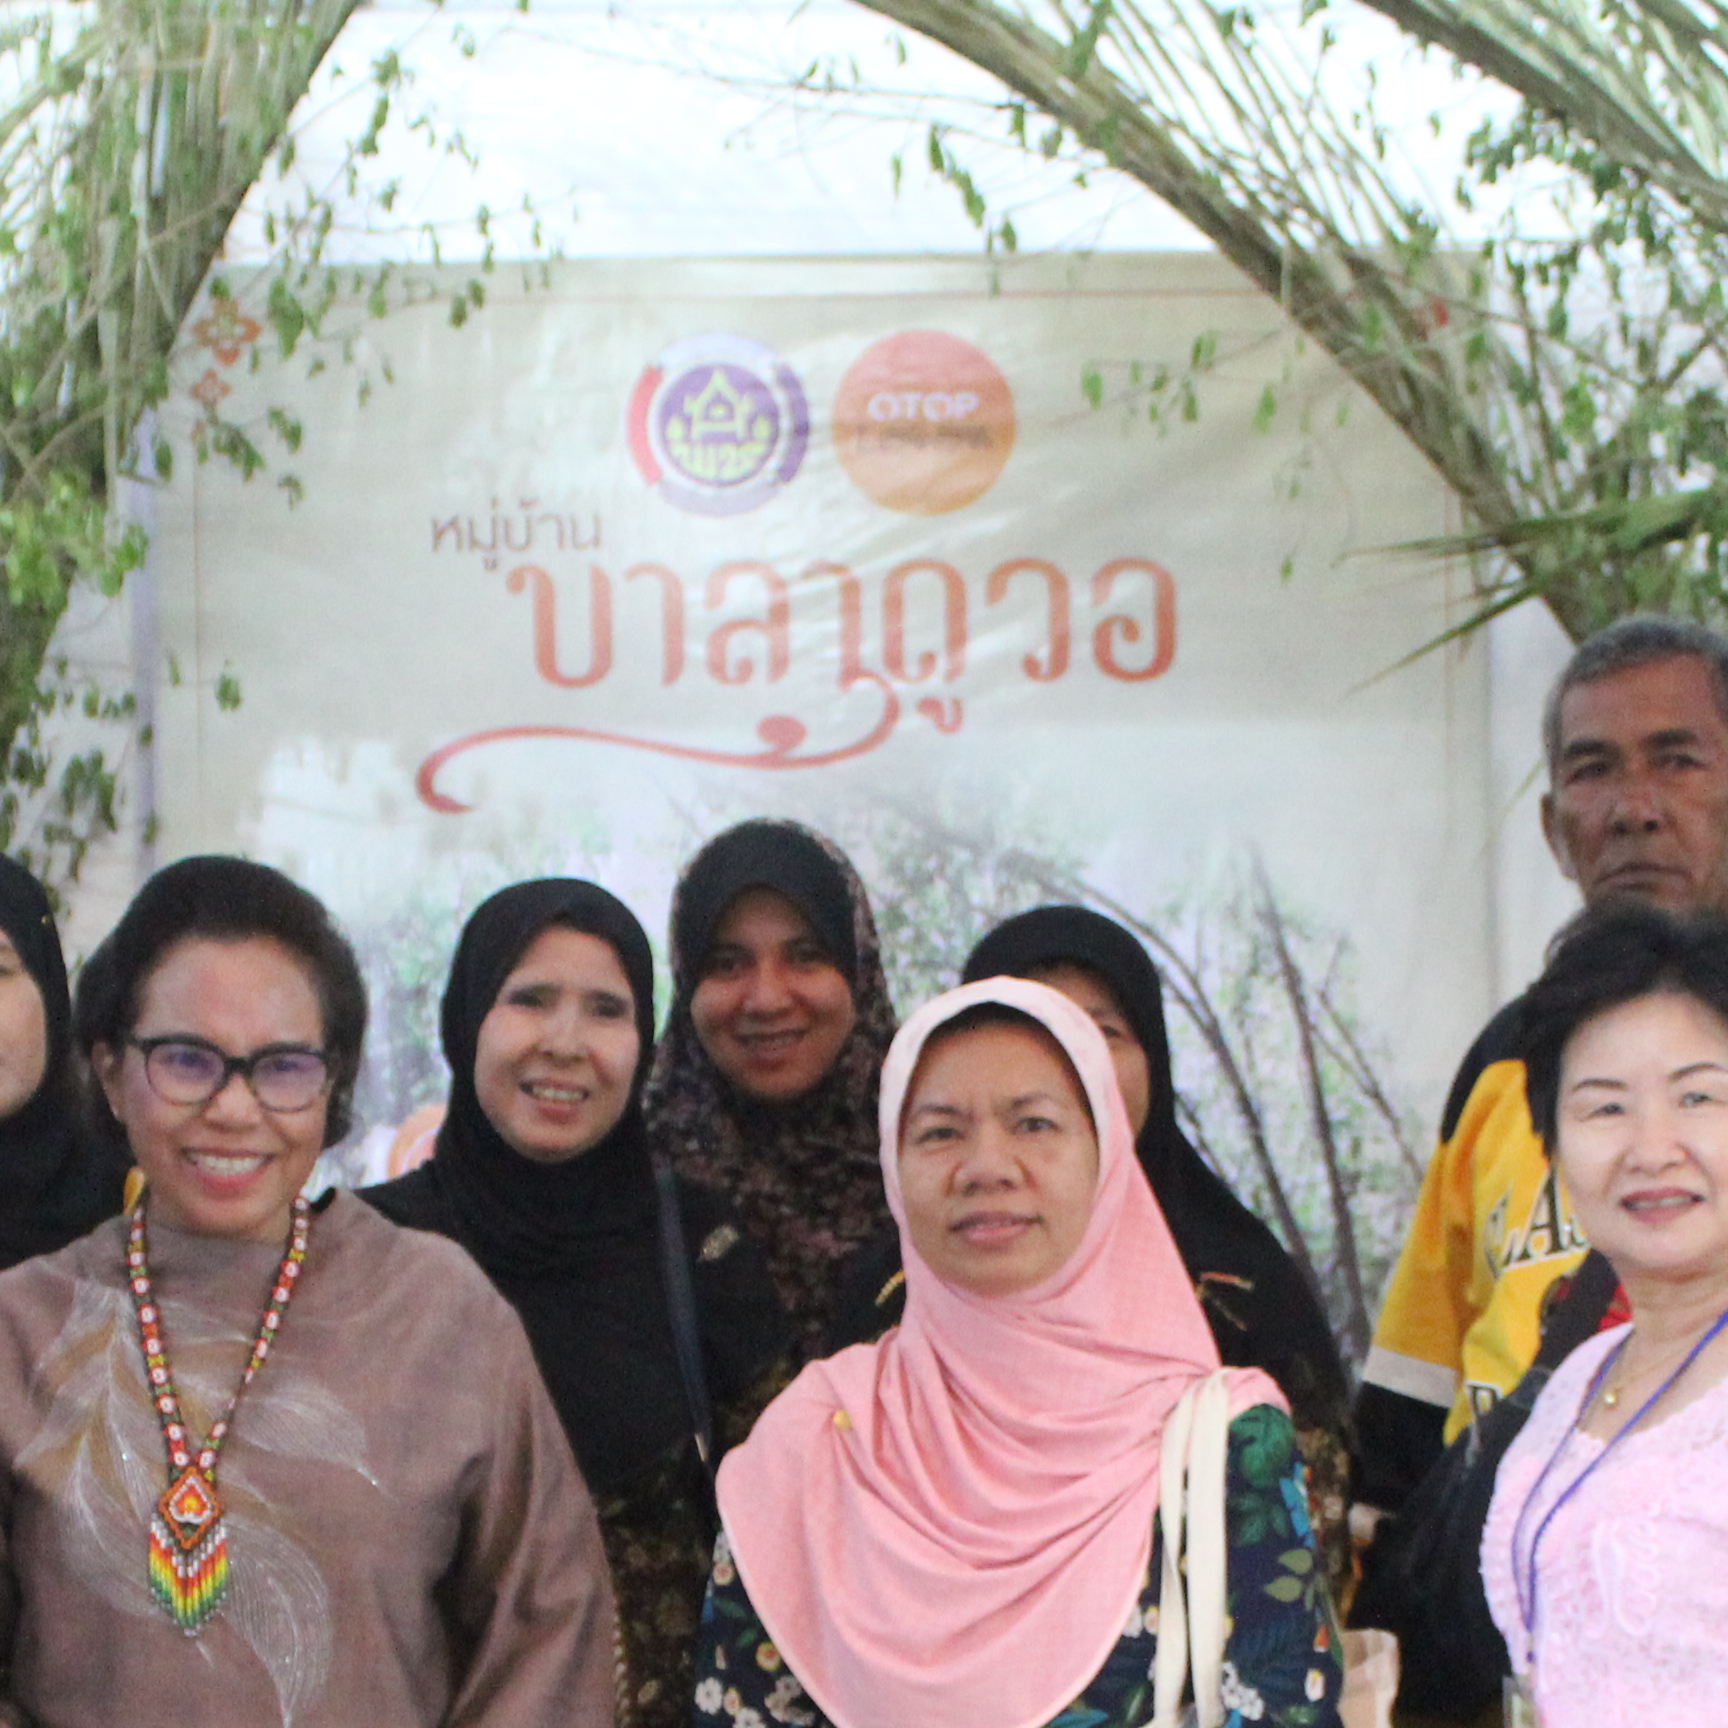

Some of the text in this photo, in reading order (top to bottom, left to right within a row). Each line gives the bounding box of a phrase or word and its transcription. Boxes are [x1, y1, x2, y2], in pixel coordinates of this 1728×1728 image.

[867, 392, 981, 421] OTOP
[431, 497, 602, 572] หมู่บ้าน
[505, 556, 1178, 736] บาลาดูวอ
